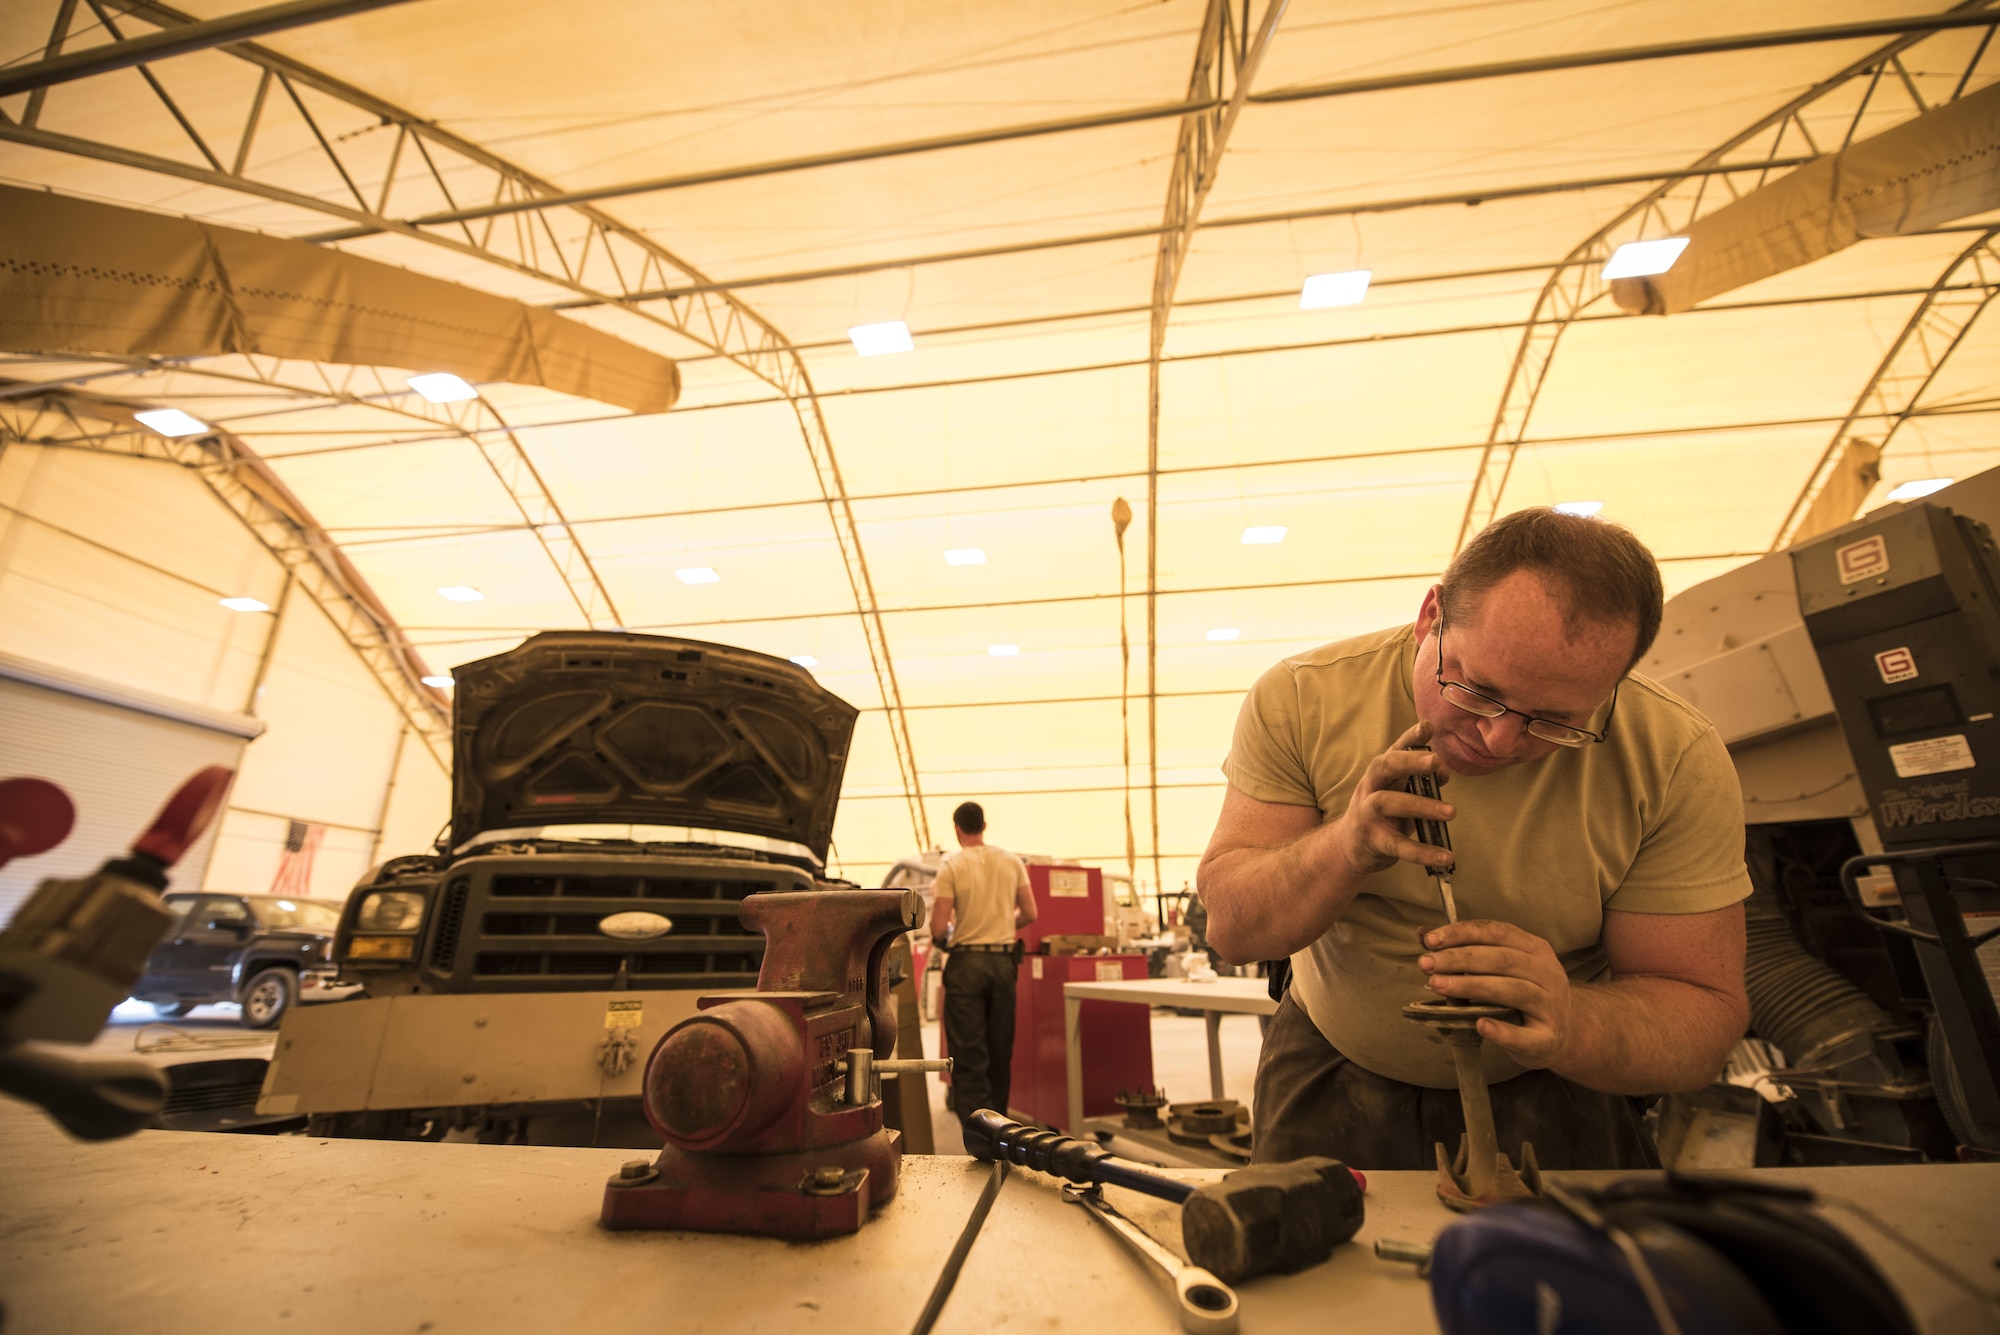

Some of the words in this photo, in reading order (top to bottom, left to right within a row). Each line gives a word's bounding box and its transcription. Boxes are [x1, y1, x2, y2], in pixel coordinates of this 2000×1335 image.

[1846, 566, 1884, 582] GRAY
[1887, 671, 1915, 682] GRAY
[1910, 779, 1969, 798] Original
